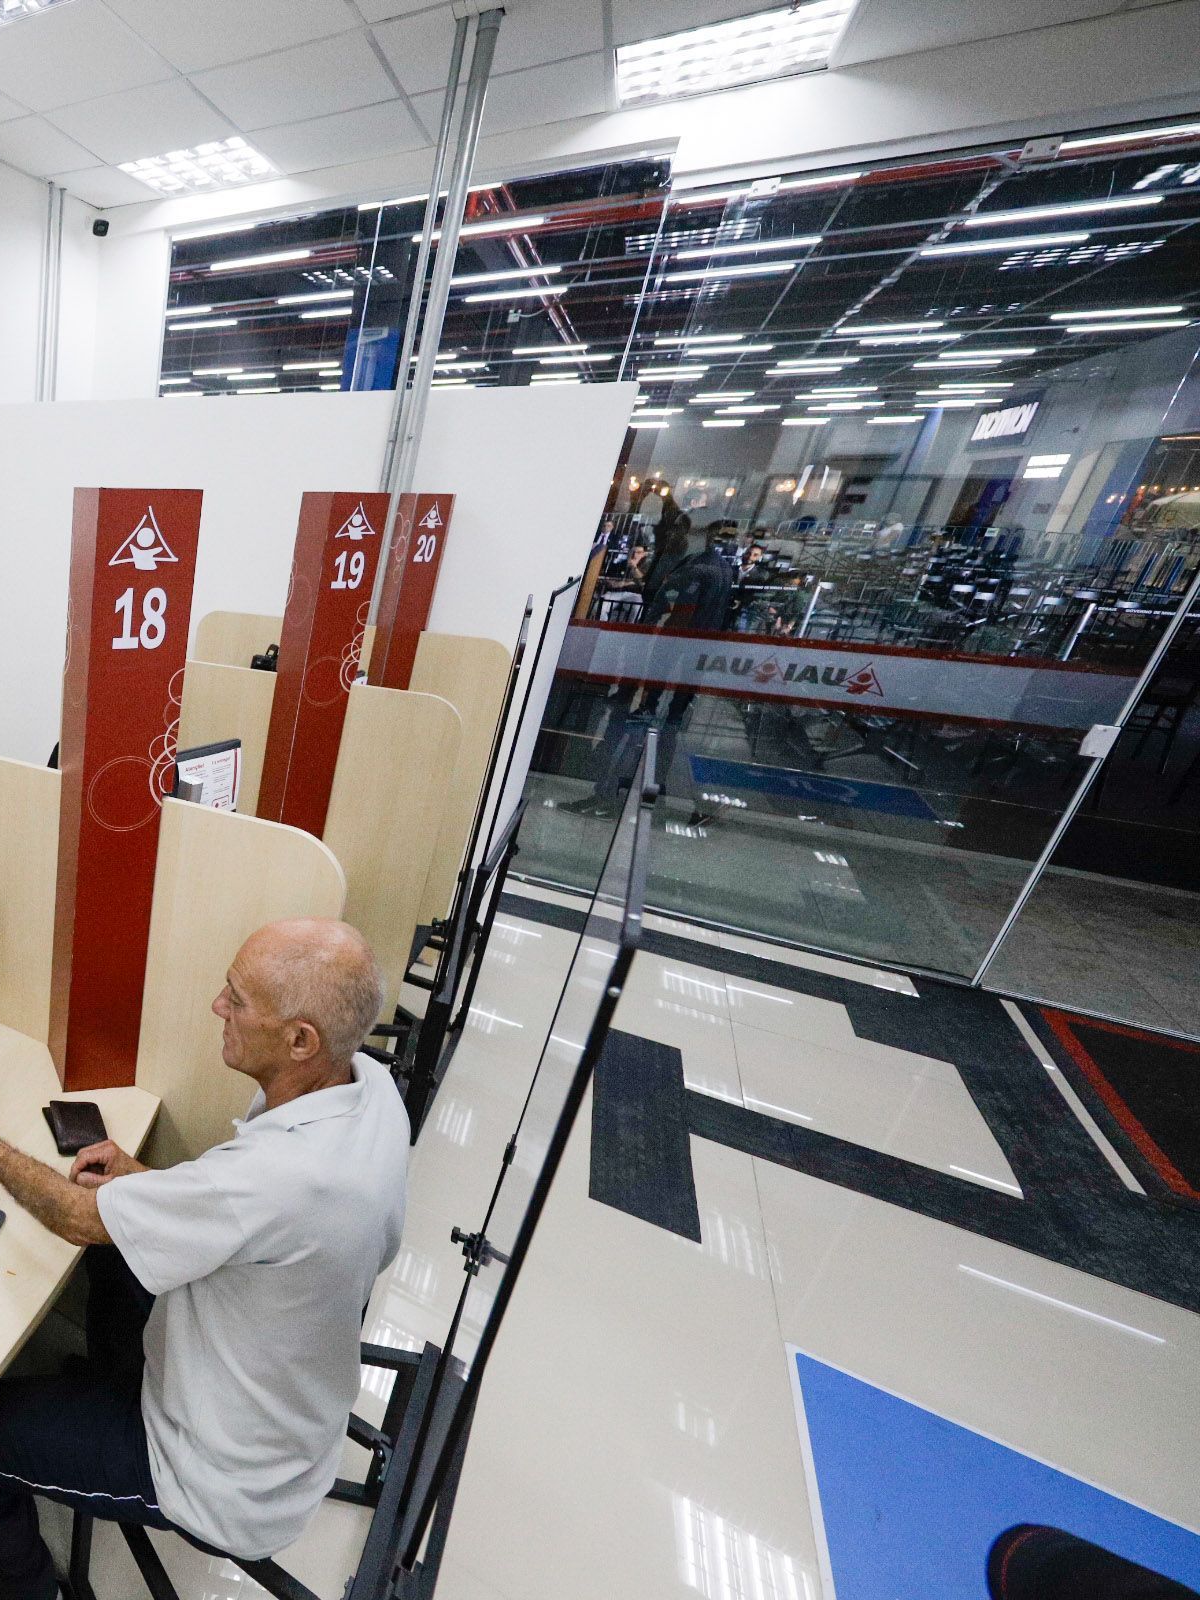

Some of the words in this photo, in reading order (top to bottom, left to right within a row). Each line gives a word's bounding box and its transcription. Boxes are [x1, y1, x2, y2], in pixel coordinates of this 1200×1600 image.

[413, 534, 436, 563] 20
[330, 550, 365, 590] 19
[111, 587, 167, 650] 18
